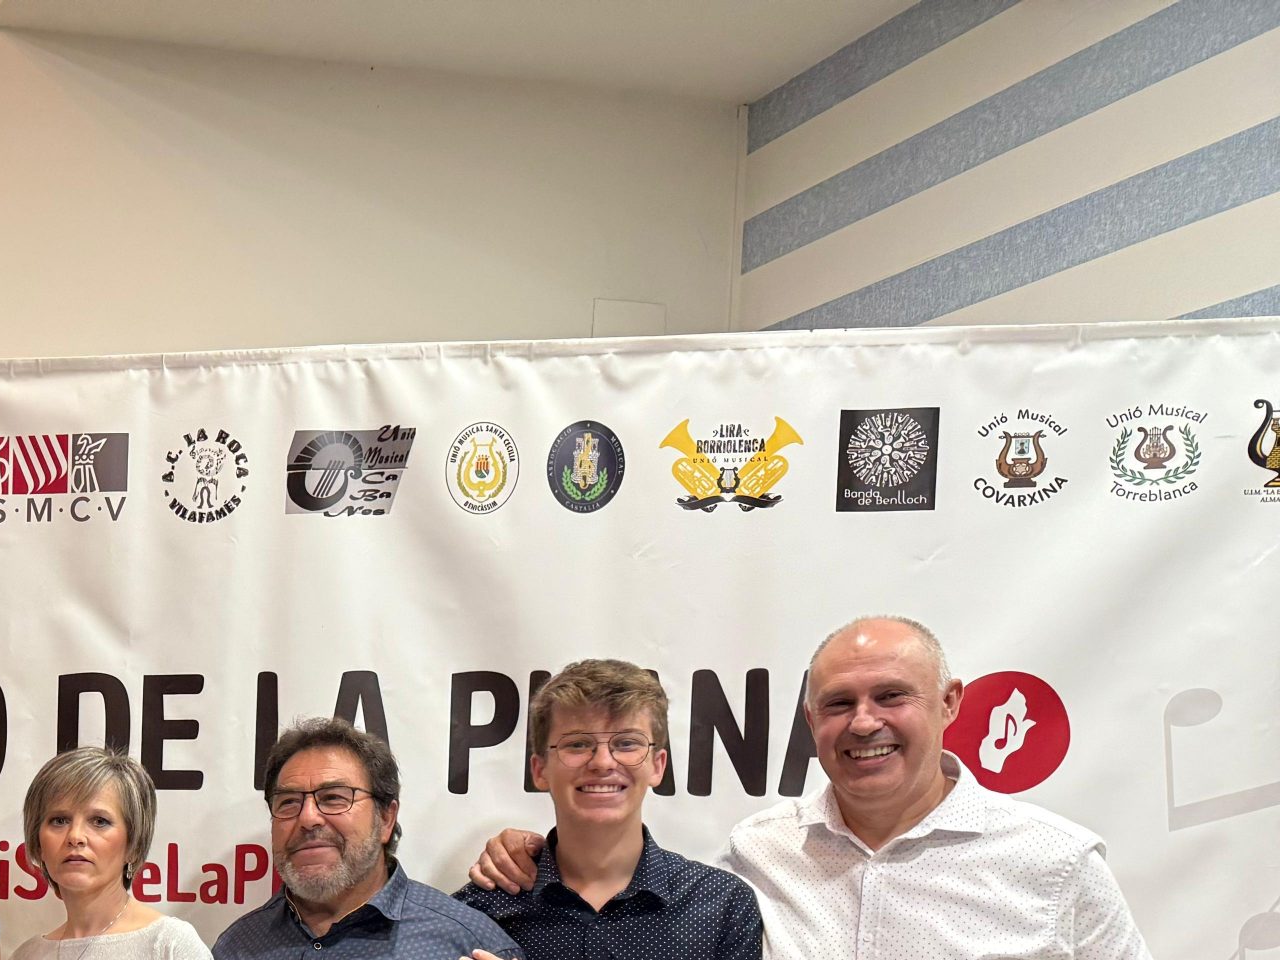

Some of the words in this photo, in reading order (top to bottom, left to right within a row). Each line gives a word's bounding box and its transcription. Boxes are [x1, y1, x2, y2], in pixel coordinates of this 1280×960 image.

[977, 413, 1009, 438] Unió
[1017, 408, 1068, 437] Musical
[1105, 406, 1143, 428] Unió
[1147, 403, 1209, 424] Musical
[720, 424, 743, 438] LIRA
[214, 429, 249, 479] ROCA
[460, 425, 484, 445] MUSICAL
[485, 425, 505, 440] SANTA
[503, 438, 516, 463] CECILIA
[844, 488, 880, 499] Banda
[857, 496, 873, 506] de
[875, 488, 928, 505] Benlloch
[973, 475, 1069, 508] COVARXINA
[1109, 480, 1199, 502] Torreblanca
[57, 672, 205, 791] DE
[447, 670, 822, 797] PNA
